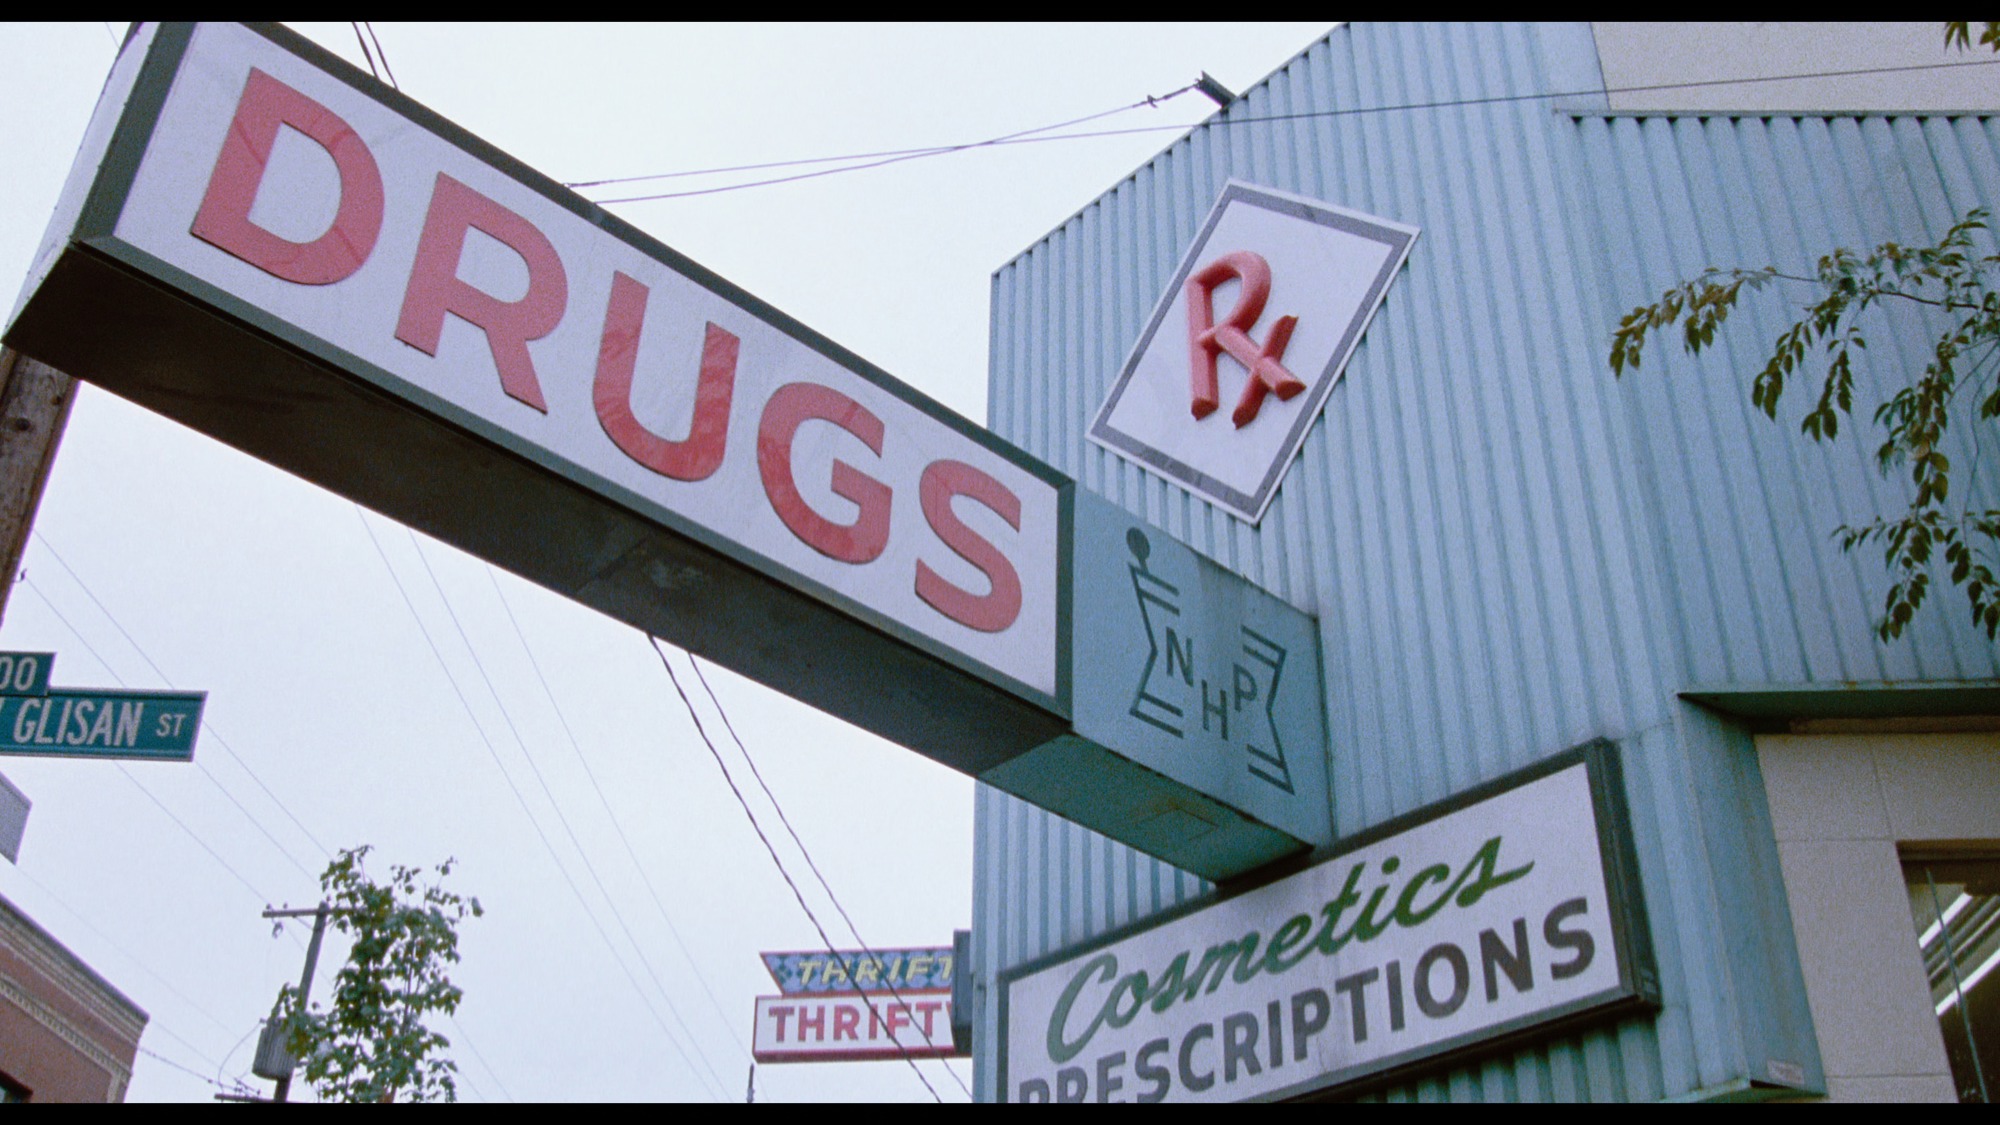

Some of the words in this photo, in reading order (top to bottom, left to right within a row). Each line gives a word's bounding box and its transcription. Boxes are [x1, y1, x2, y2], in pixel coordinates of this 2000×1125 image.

[190, 66, 1023, 633] DRUGS
[13, 698, 144, 746] GLISAN
[156, 713, 187, 738] ST
[1046, 836, 1535, 1064] Cosmetics
[768, 1000, 952, 1042] THRIFT
